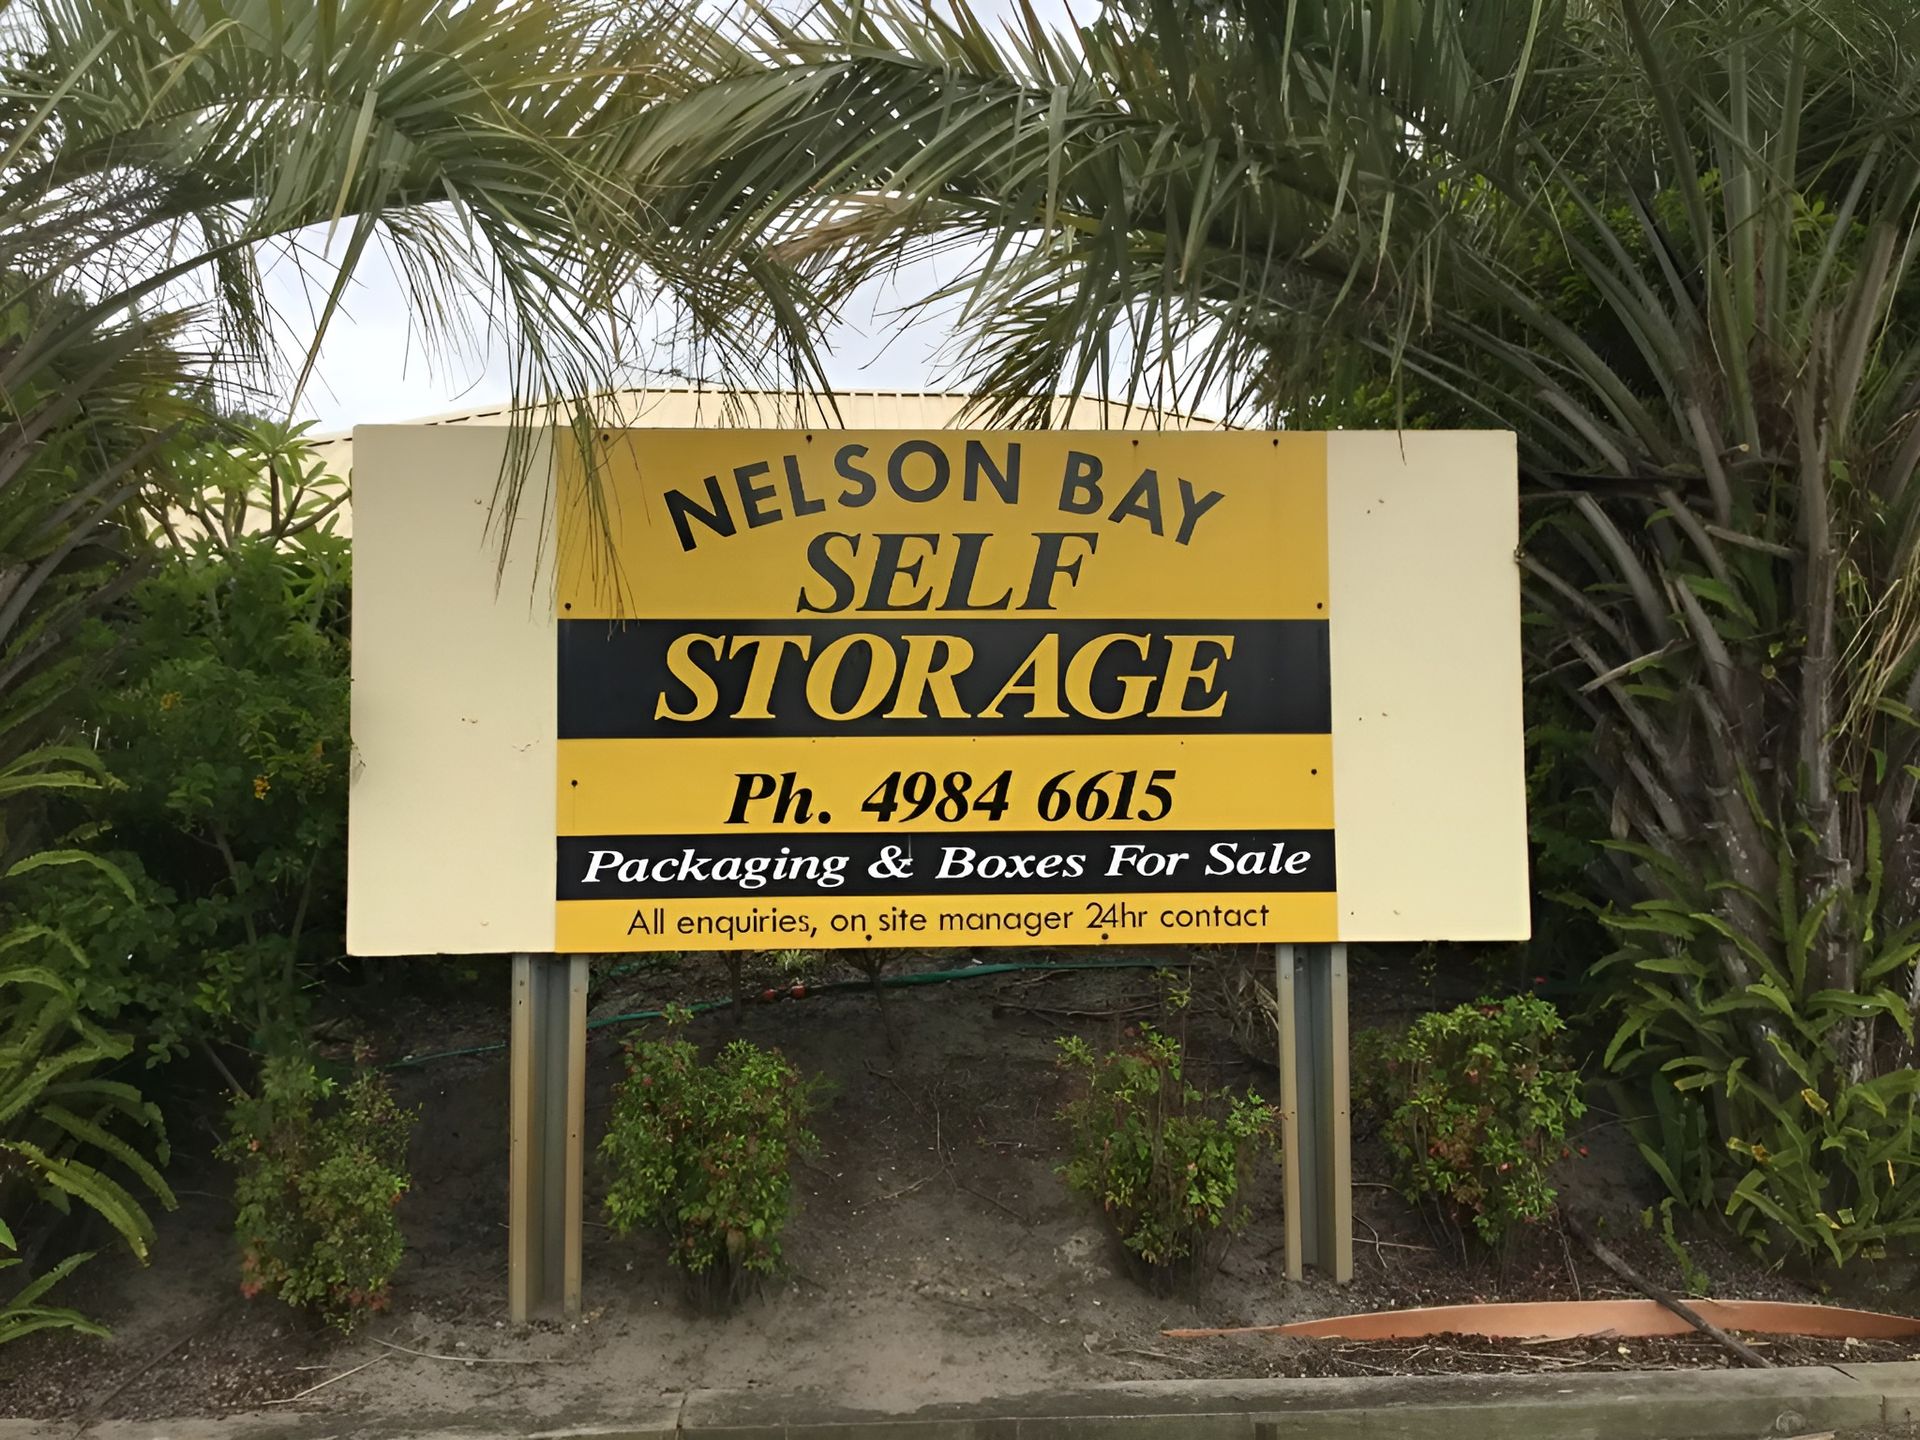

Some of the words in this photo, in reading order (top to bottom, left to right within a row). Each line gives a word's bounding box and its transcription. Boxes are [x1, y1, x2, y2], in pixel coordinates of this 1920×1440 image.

[663, 439, 1021, 553] NELSON
[1056, 454, 1226, 547] BAY
[796, 531, 1099, 614] SELF
[653, 632, 1235, 722] STORAGE
[723, 771, 832, 825] Ph.
[860, 770, 1013, 823] 4984
[1037, 769, 1177, 822] 6615
[580, 846, 850, 890] Packaging
[867, 845, 914, 879] &
[934, 846, 1087, 879] Boxes
[1103, 844, 1190, 877] For
[1204, 842, 1311, 876] Sale
[627, 907, 664, 936] All
[677, 907, 817, 941] enquiries,
[830, 914, 866, 932] on
[878, 906, 927, 932] site
[939, 911, 1074, 937] manager
[1086, 901, 1148, 929] 24hr
[1160, 904, 1270, 928] contact
